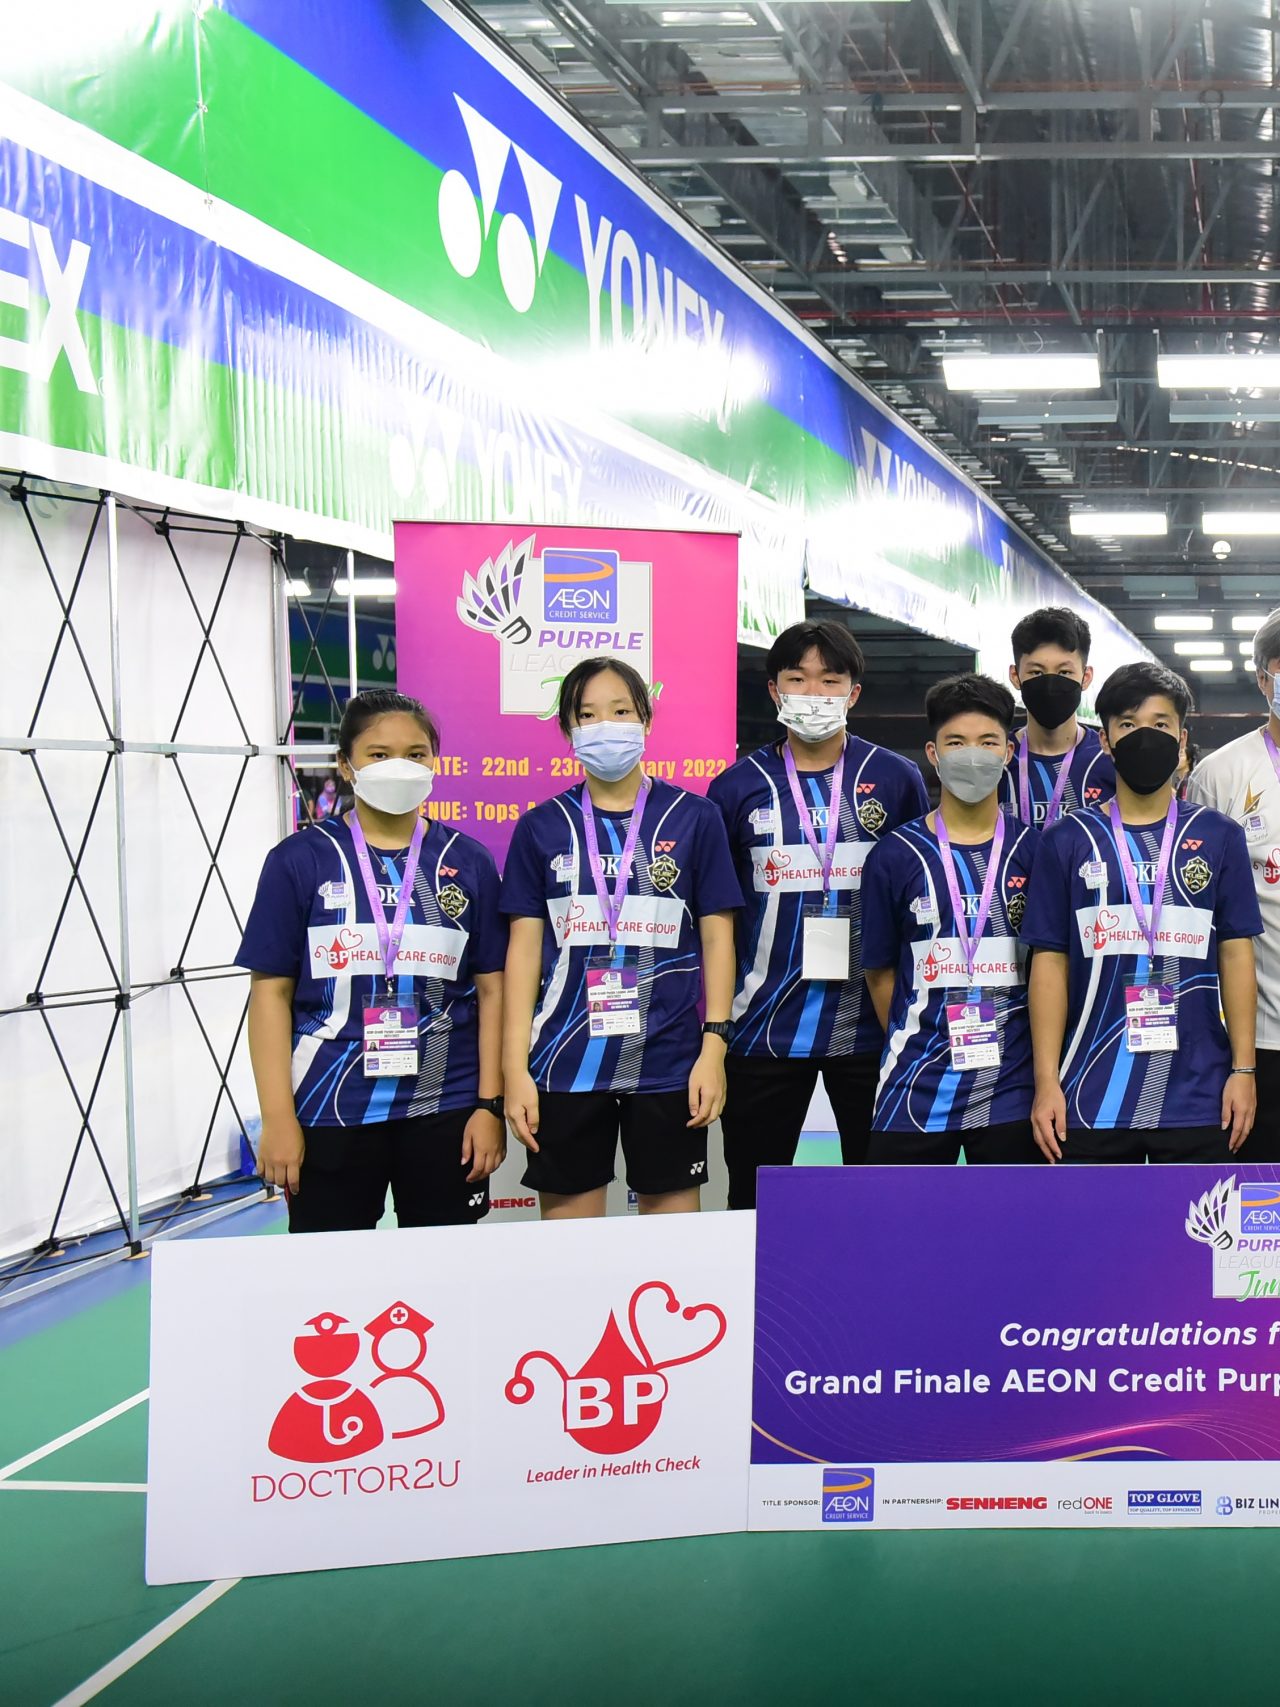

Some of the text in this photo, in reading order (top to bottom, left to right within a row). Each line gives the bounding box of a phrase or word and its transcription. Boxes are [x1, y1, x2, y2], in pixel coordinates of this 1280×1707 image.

[549, 610, 610, 619] CREDIT SERVICE
[537, 630, 644, 650] PURPLE
[432, 757, 468, 776] ATE:
[481, 757, 529, 776] 22nd
[550, 758, 586, 776] 23r
[682, 759, 727, 778] 2022
[419, 802, 468, 821] ENUE:
[474, 802, 520, 823] Tops
[764, 869, 781, 881] BP
[1264, 867, 1280, 879] BP
[573, 919, 643, 933] HEALTCARE
[1109, 930, 1172, 943] HEALTHARE
[1174, 932, 1206, 945] GROUP
[327, 949, 458, 967] BP HEALCARE GROUP
[924, 964, 939, 976] BP
[941, 962, 1008, 975] HEALHCARE
[489, 1197, 535, 1210] HENG
[1000, 1321, 1257, 1351] Congratulations
[785, 1370, 882, 1395] Grand
[894, 1367, 991, 1394] Finale
[1001, 1368, 1097, 1394] AEON
[1108, 1366, 1206, 1394] Credit
[567, 1373, 666, 1431] BP
[526, 1455, 702, 1483] Leader in Health Check
[251, 1458, 461, 1502] DOCTOR2U
[946, 1496, 1048, 1510] SENHENG
[1057, 1496, 1113, 1510] redONE
[1129, 1493, 1201, 1503] TOP GLOVE
[1235, 1498, 1255, 1508] BIZ
